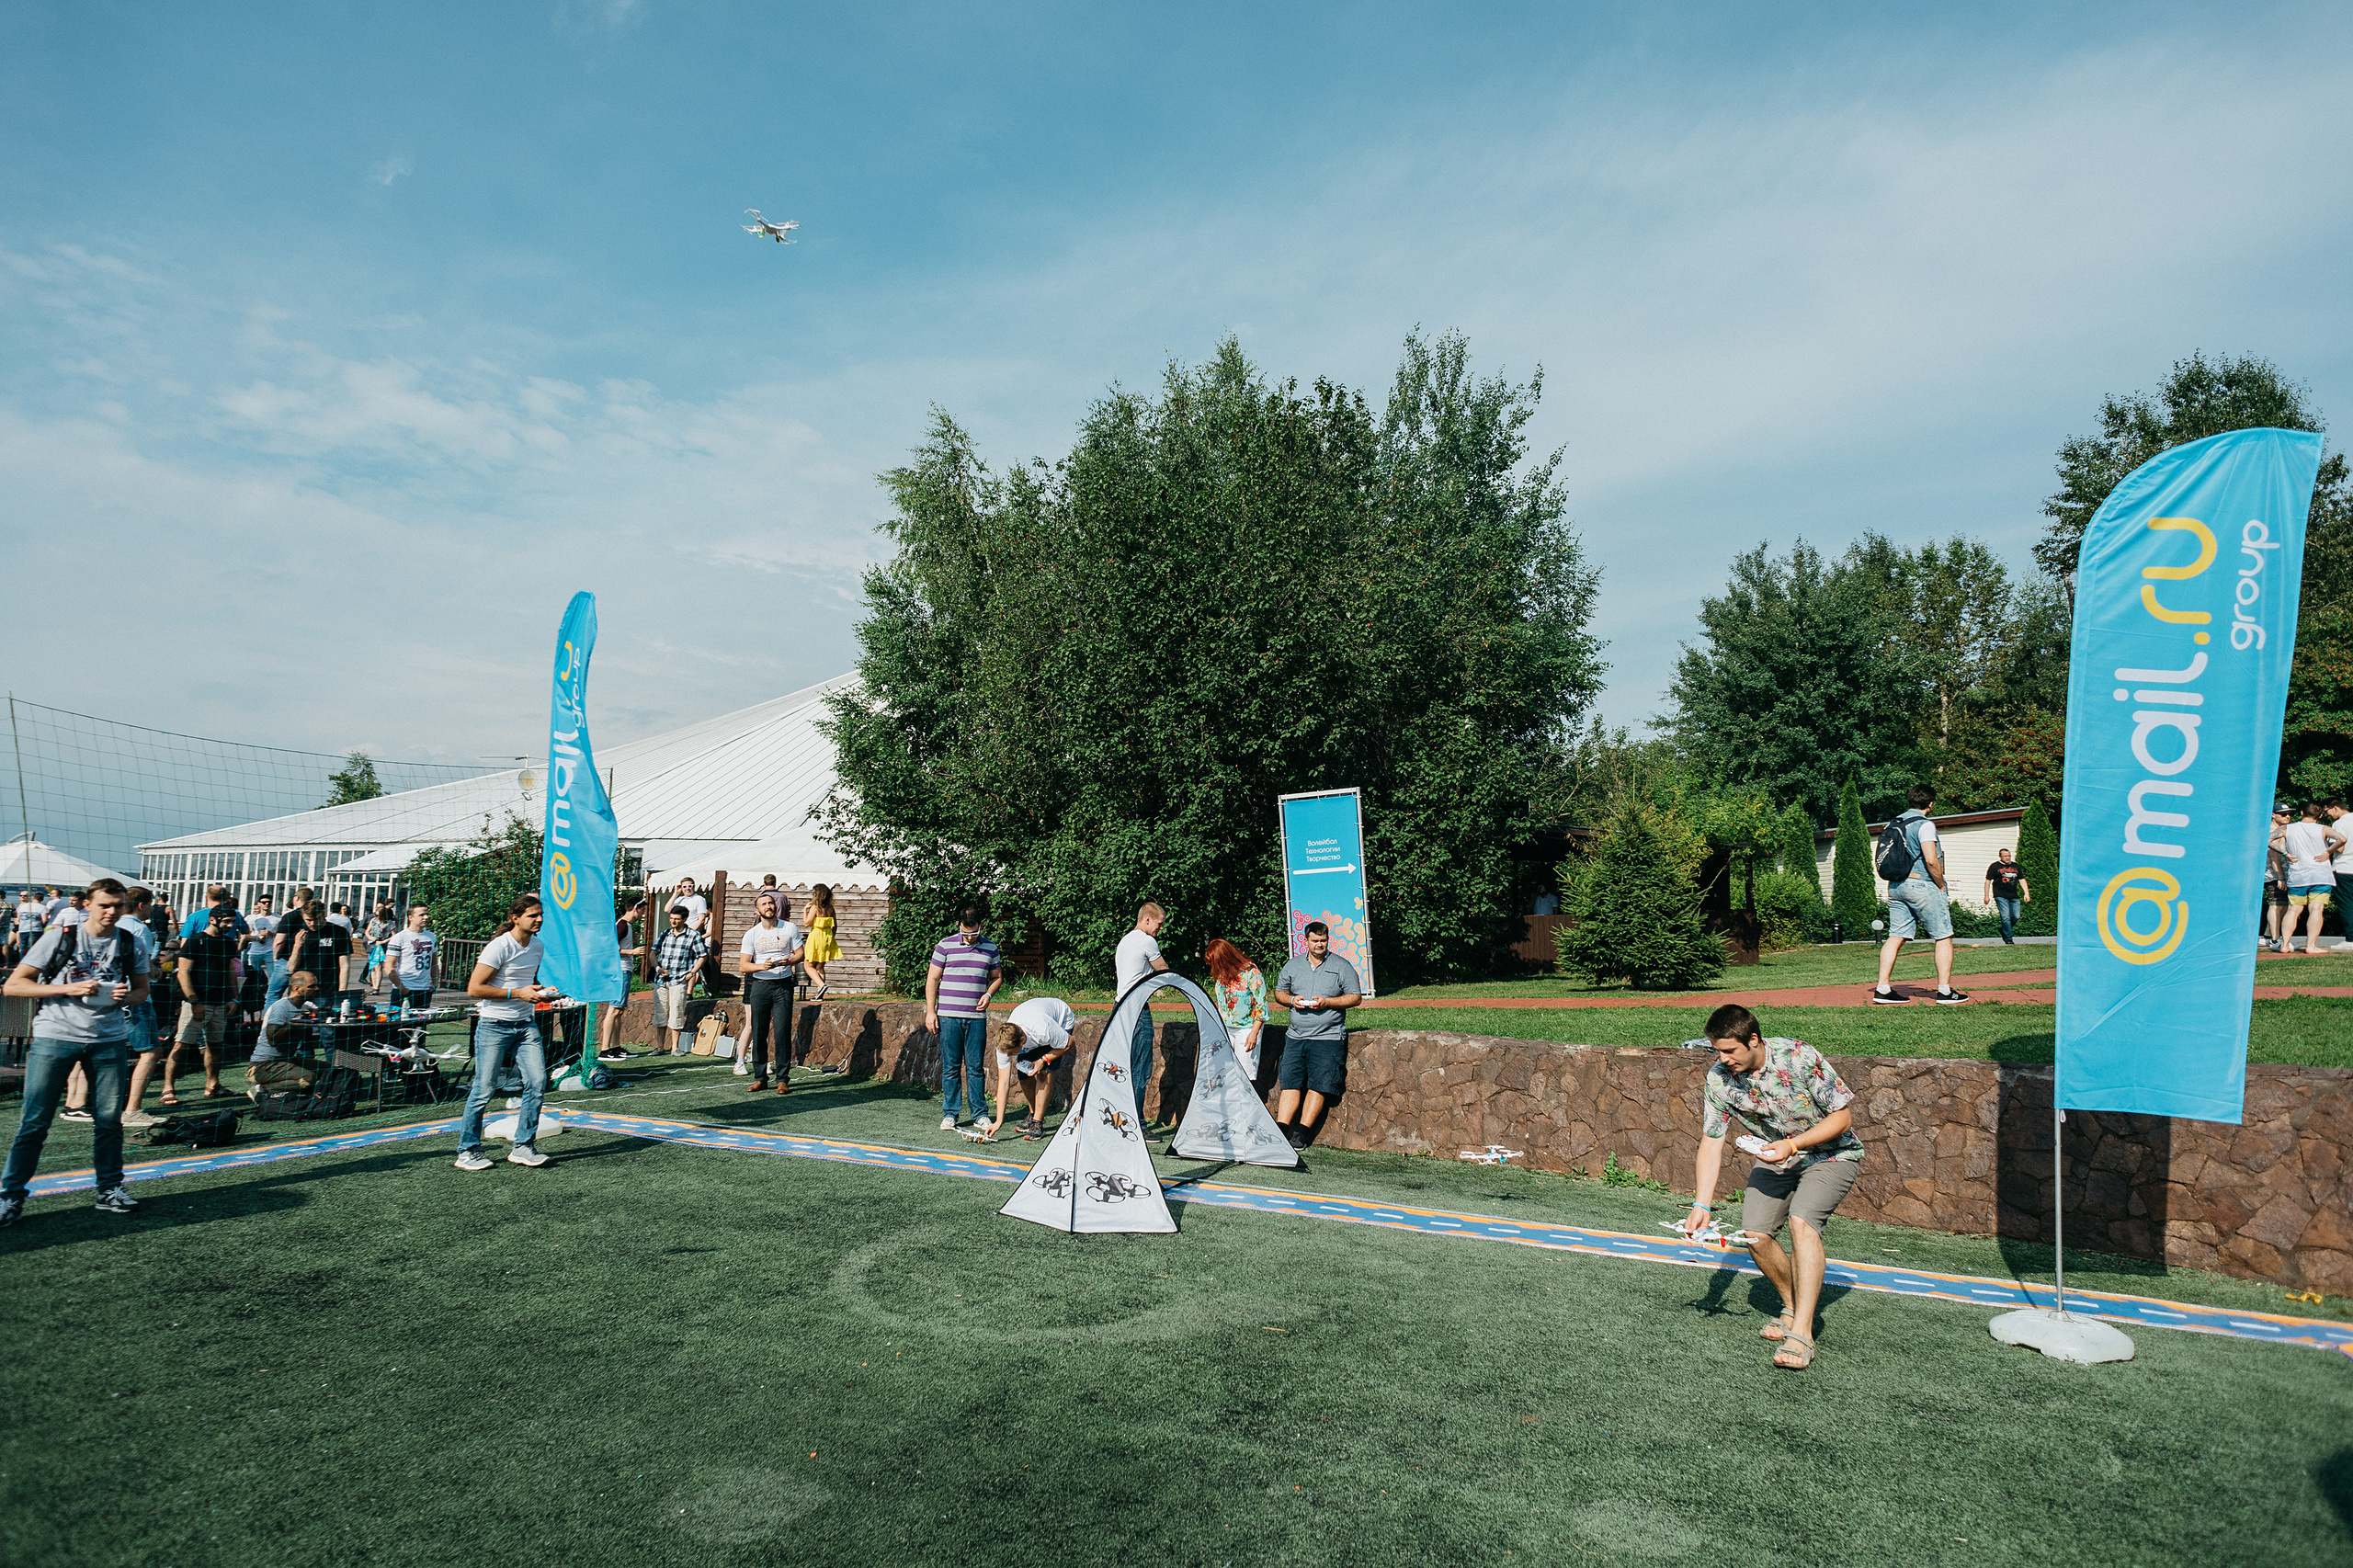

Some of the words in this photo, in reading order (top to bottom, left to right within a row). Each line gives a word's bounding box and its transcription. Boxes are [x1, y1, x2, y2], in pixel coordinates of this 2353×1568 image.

[2230, 519, 2280, 651] group
[572, 647, 585, 728] group
[2097, 517, 2217, 966] @mail.ru
[550, 640, 581, 911] @mailu
[1305, 846, 1341, 855] Технологии
[1306, 855, 1341, 863] Творчество
[1307, 837, 1338, 846] Волейбол
[415, 955, 431, 971] 63
